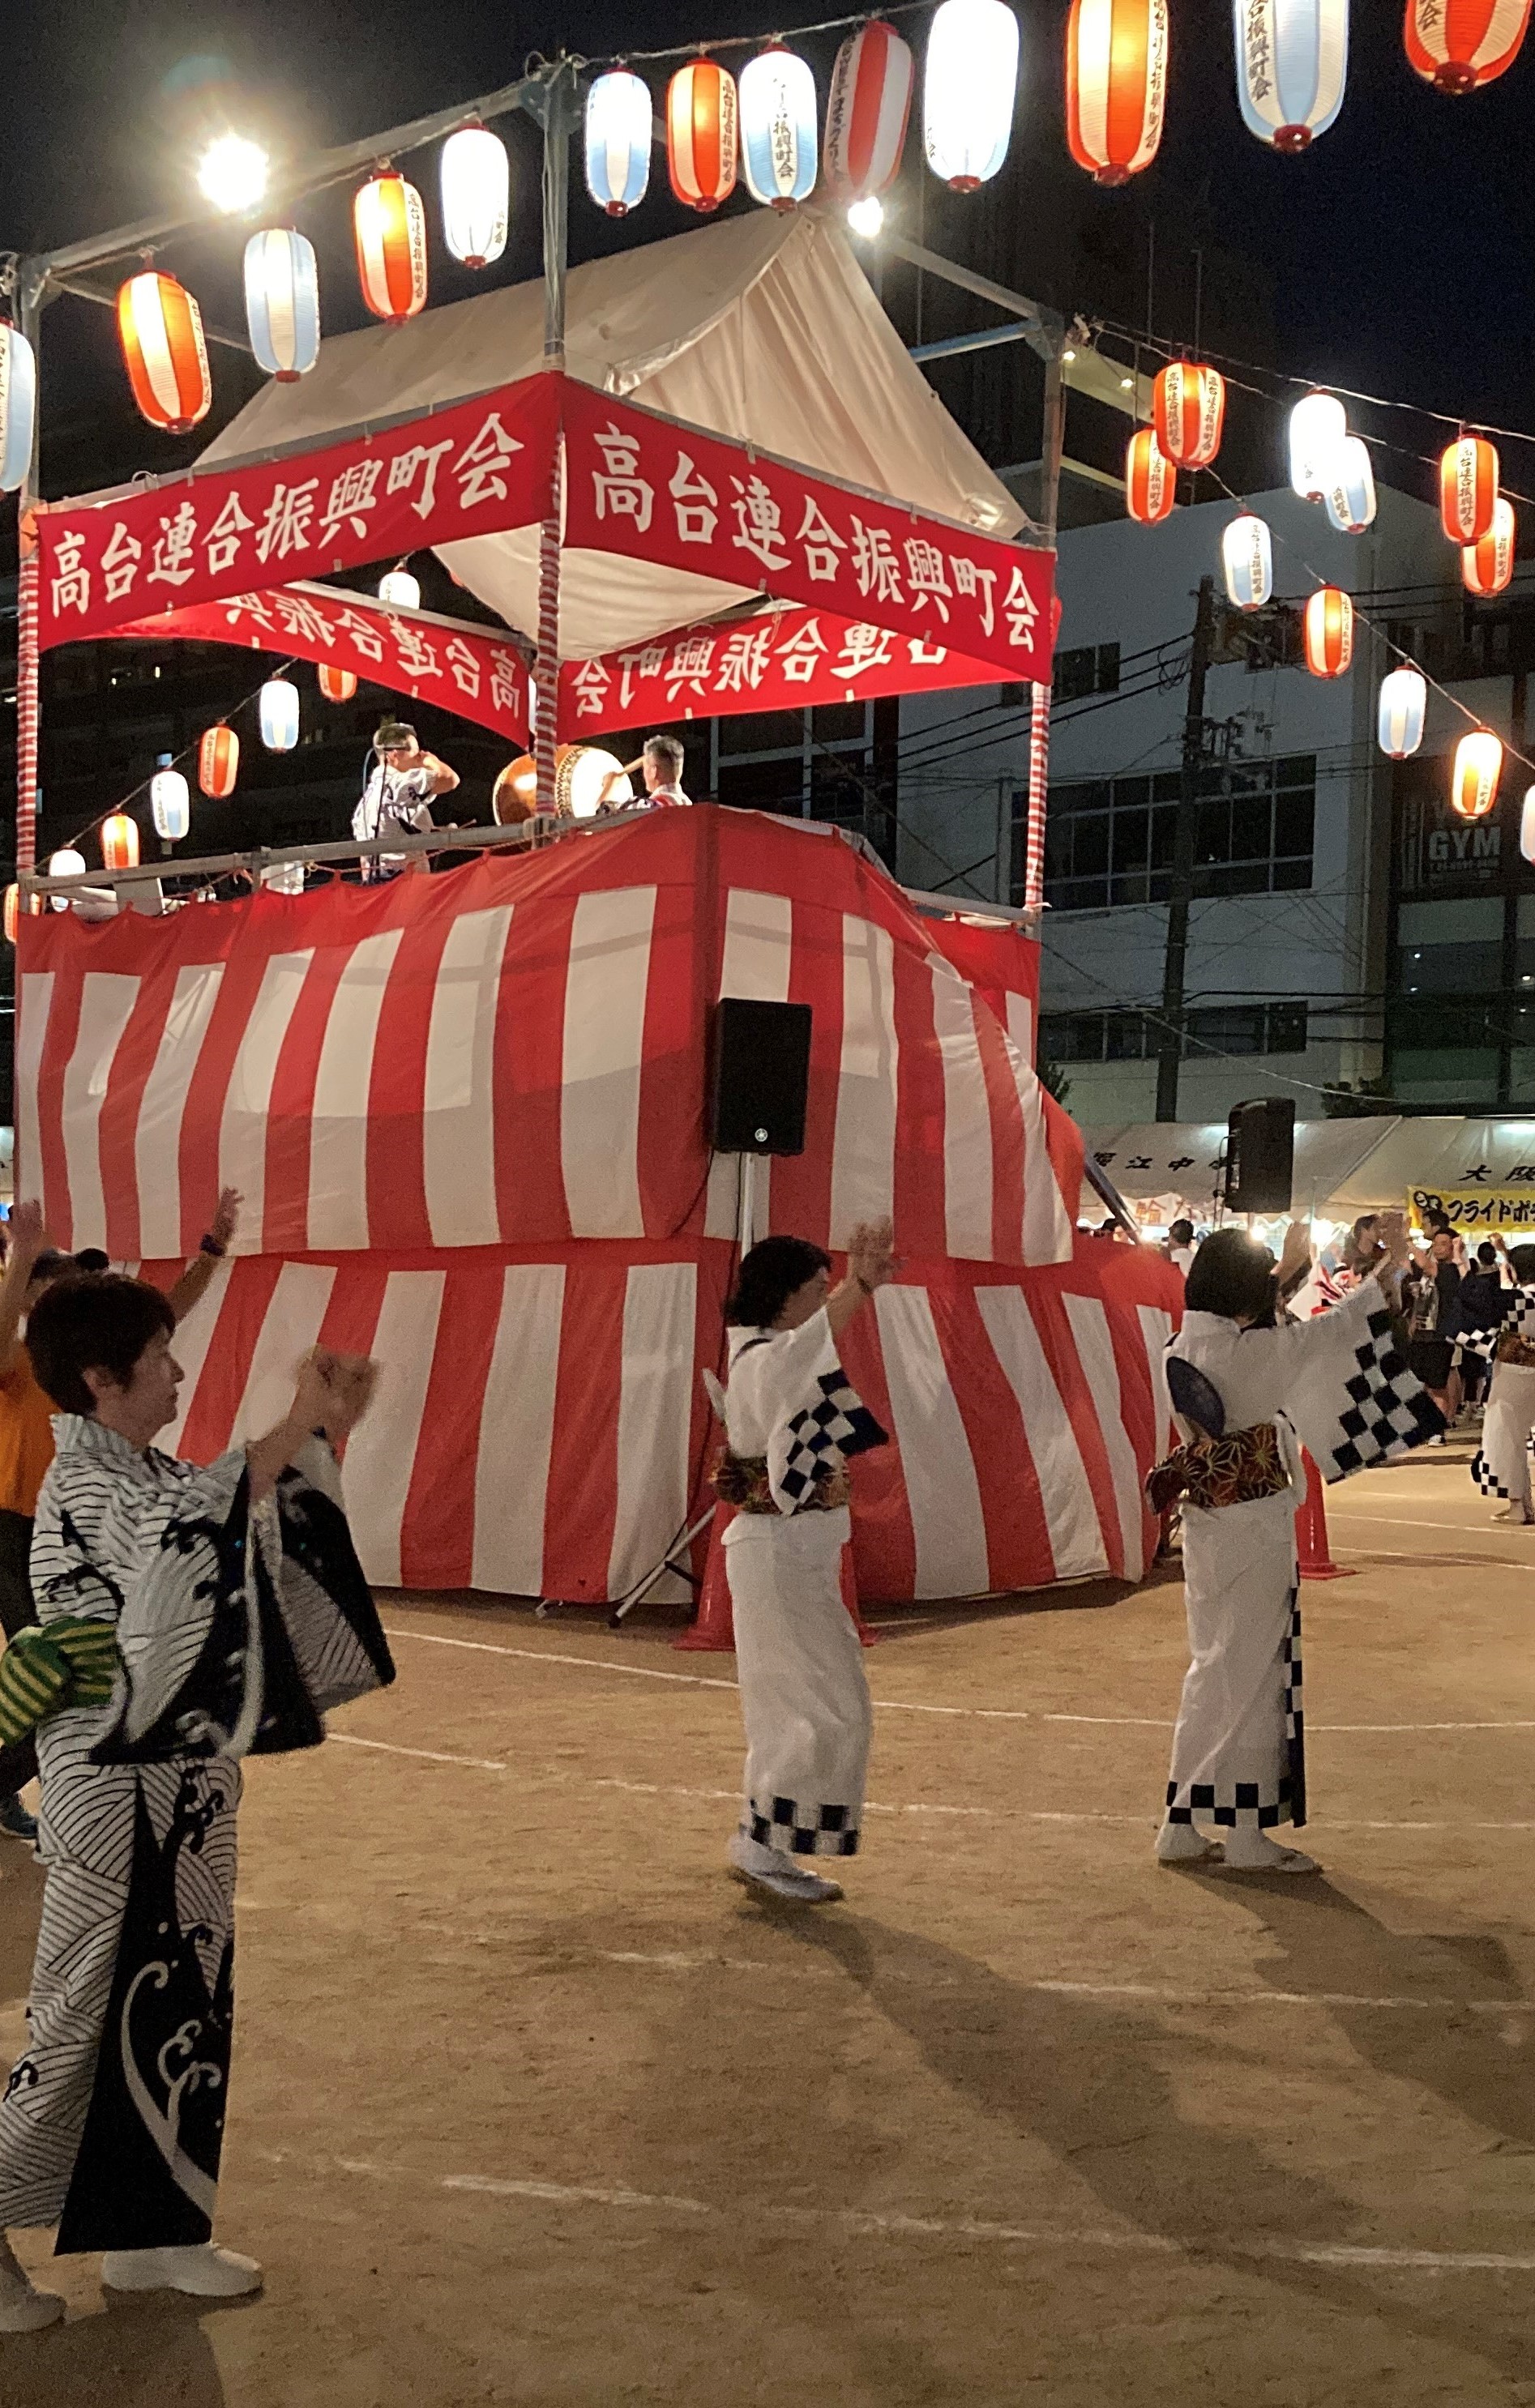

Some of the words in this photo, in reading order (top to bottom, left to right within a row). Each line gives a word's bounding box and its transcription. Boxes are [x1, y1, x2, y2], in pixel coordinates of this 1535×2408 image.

[51, 412, 524, 618] 高台連合振興町会
[592, 421, 1040, 653] 高台連合振興町会
[1459, 446, 1474, 526] 高台連合振興町会
[1428, 826, 1501, 860] GYM
